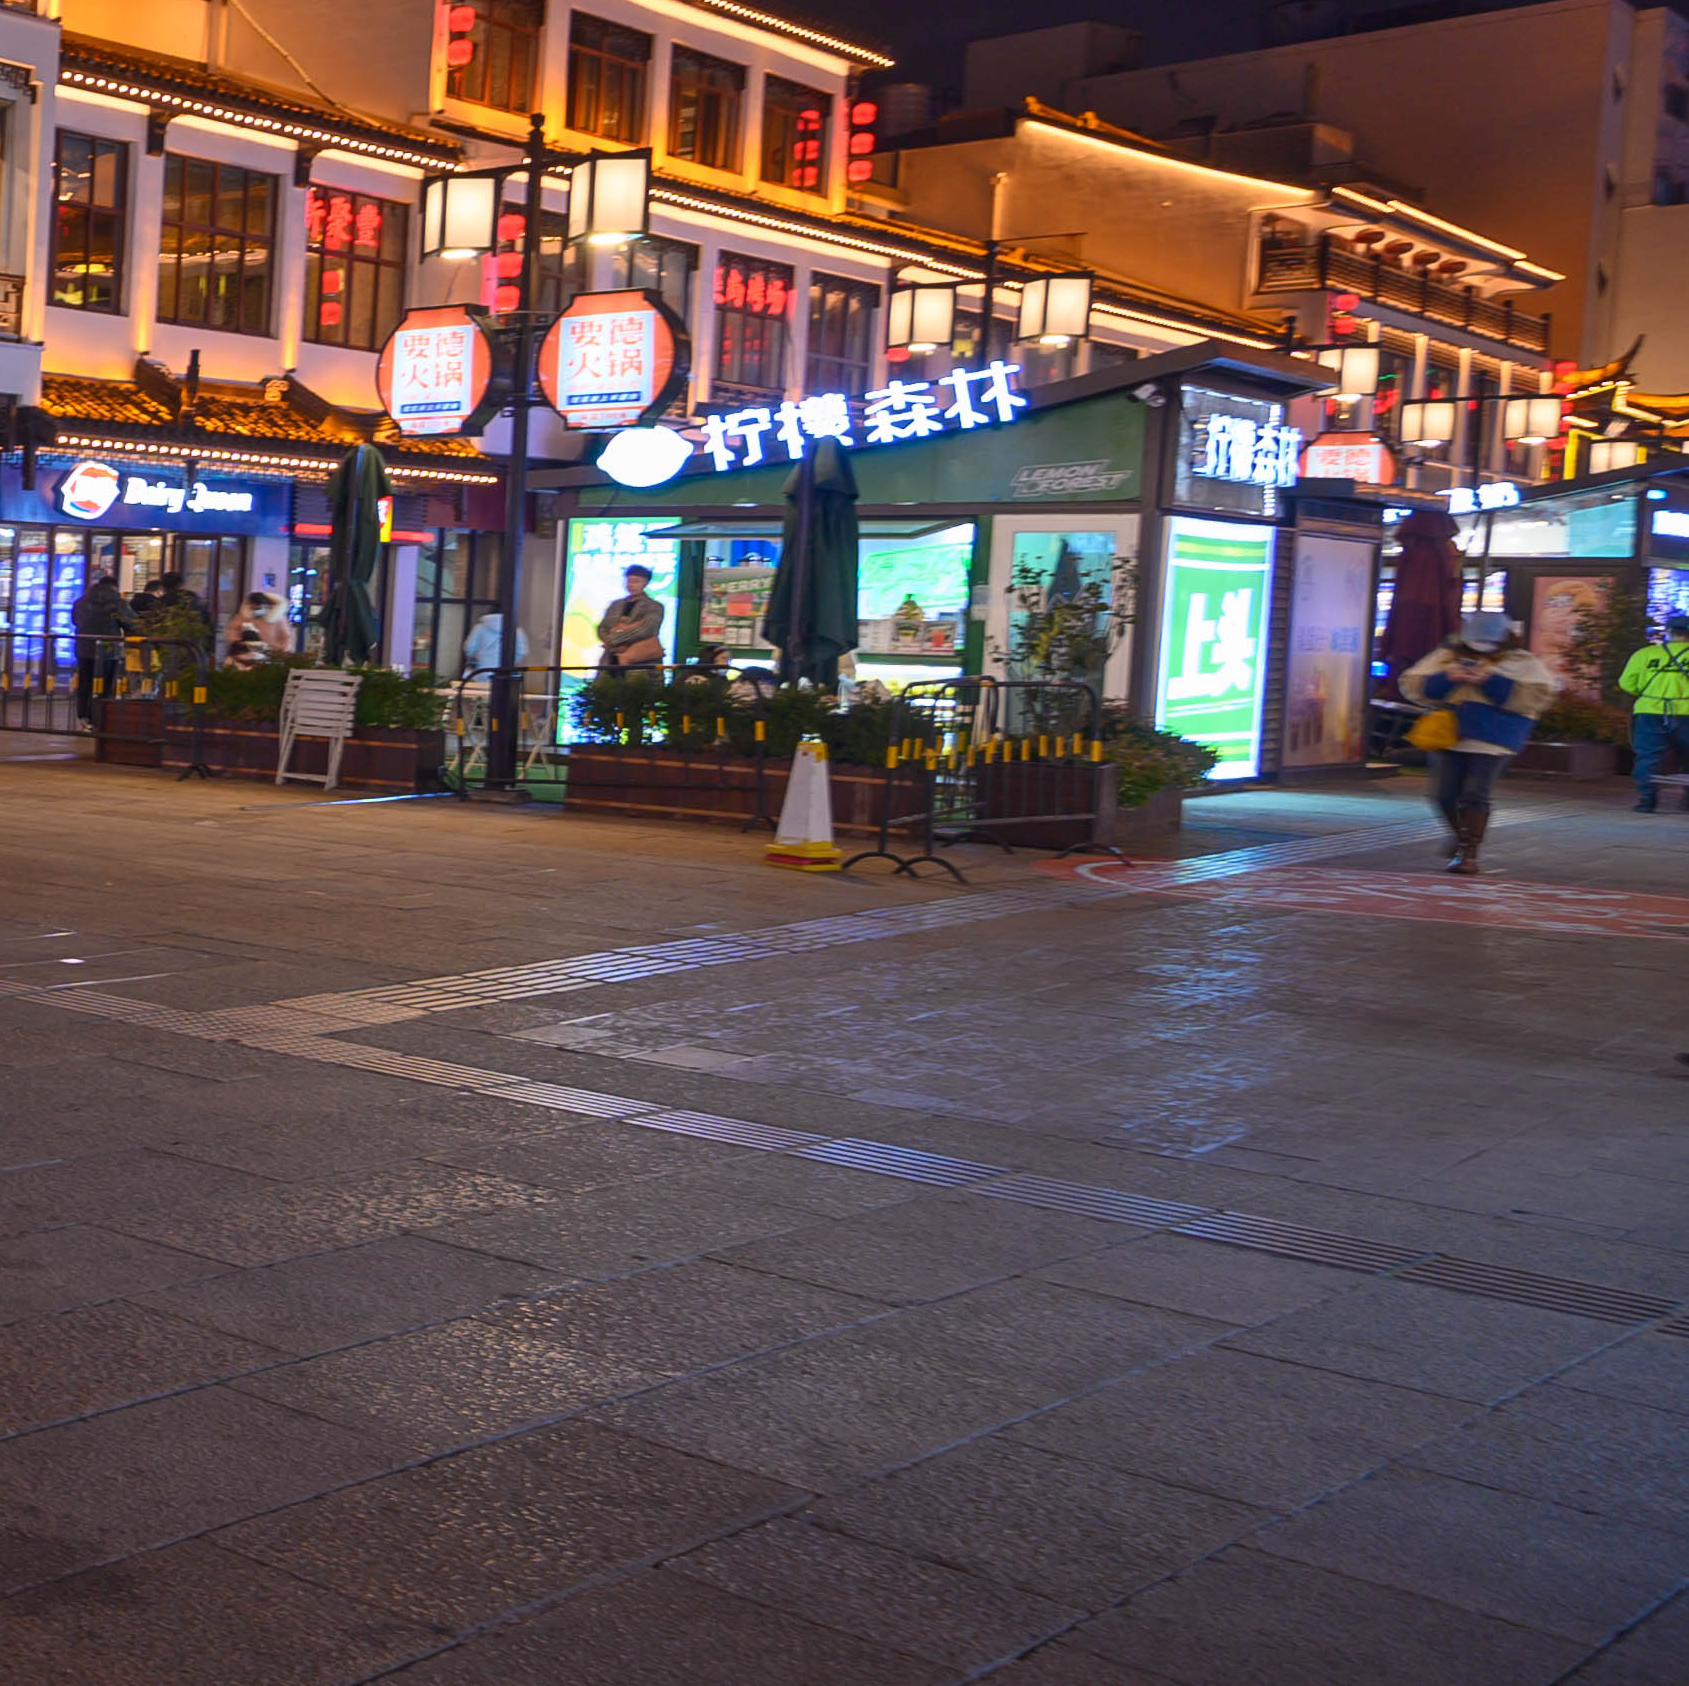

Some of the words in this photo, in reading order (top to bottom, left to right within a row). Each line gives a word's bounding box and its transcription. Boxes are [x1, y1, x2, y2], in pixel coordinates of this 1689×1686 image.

[403, 330, 466, 359] 要德
[570, 316, 644, 349] 要德
[400, 360, 464, 389] 火锅
[566, 349, 643, 380] 火锅
[1019, 465, 1102, 482] LEMON
[1038, 473, 1124, 491] FOREST
